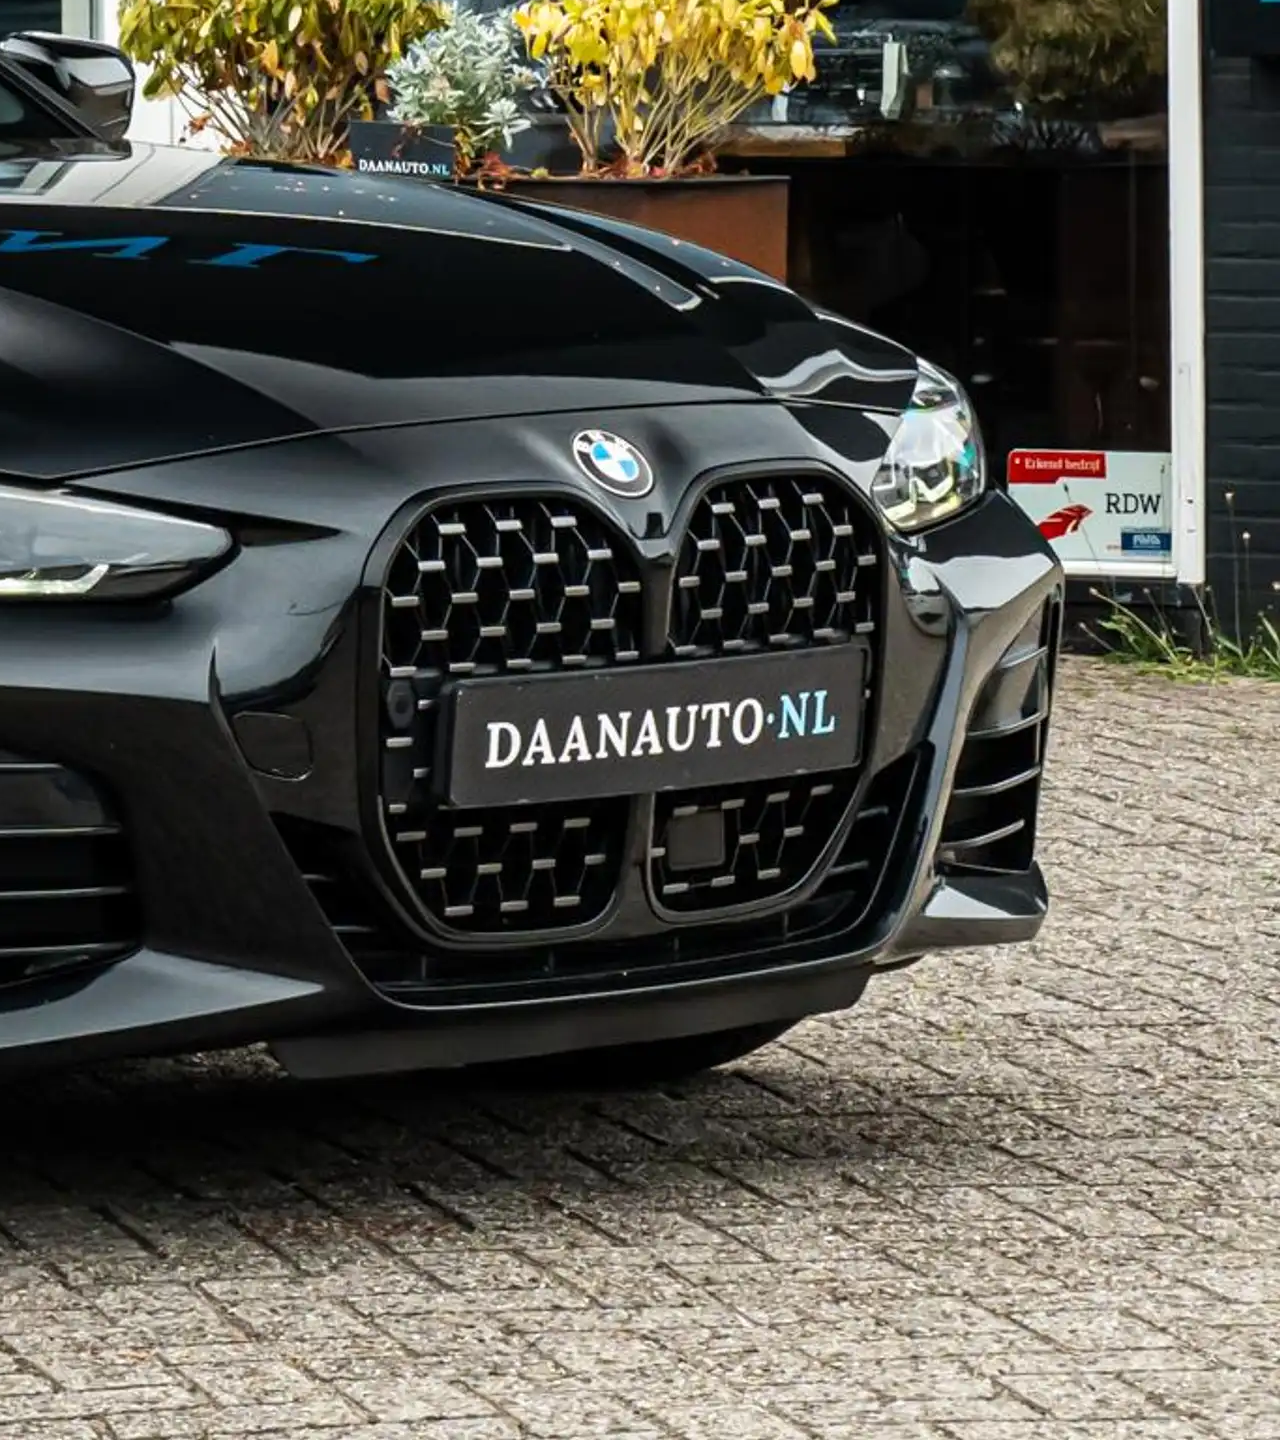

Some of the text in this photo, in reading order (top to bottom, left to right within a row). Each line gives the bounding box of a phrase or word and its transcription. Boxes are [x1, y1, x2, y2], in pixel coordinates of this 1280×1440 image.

[358, 158, 451, 176] DAANAUTO.NL
[1024, 457, 1063, 471] Erkend
[1104, 492, 1162, 515] RDW
